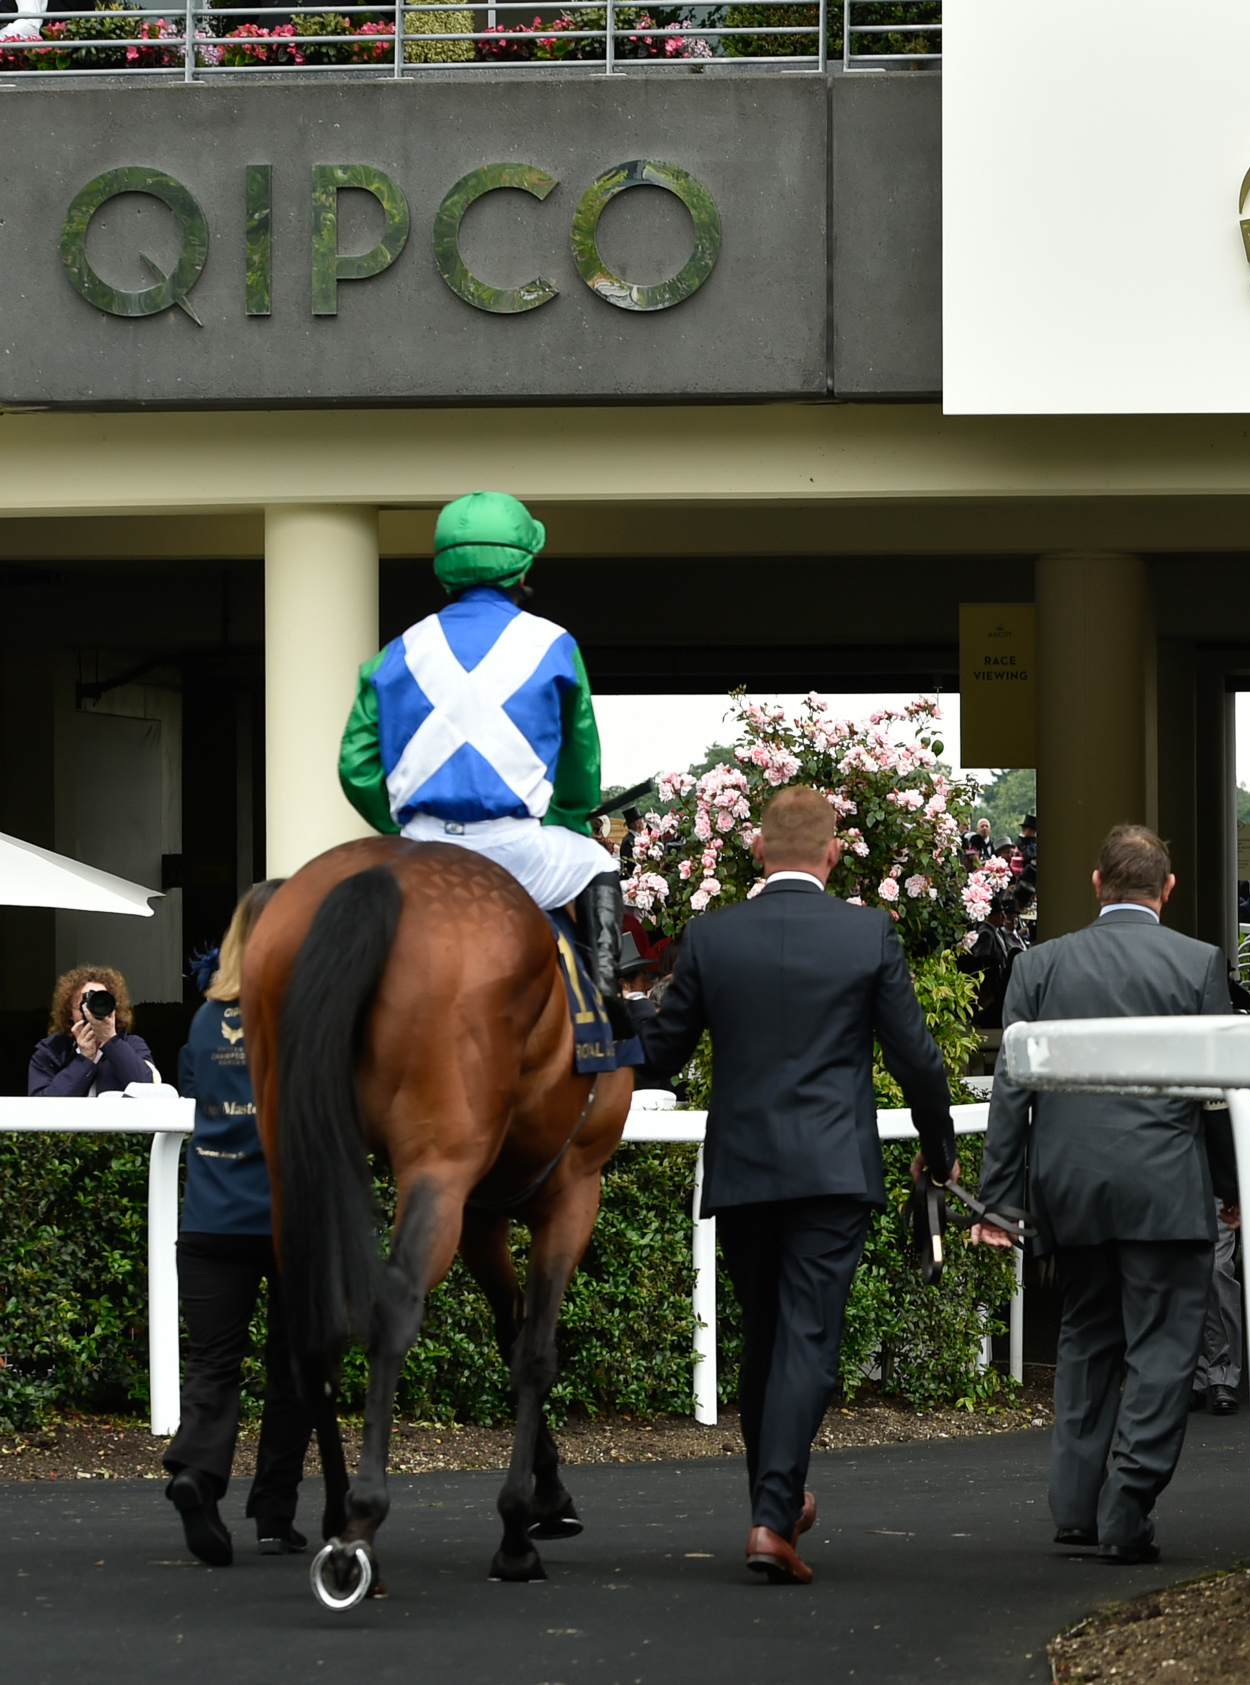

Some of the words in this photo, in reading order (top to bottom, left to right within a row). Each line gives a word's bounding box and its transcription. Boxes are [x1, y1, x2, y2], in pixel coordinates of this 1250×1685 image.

[59, 158, 723, 327] QIPCO
[984, 656, 1017, 666] RACE
[973, 671, 1028, 681] VIEWING
